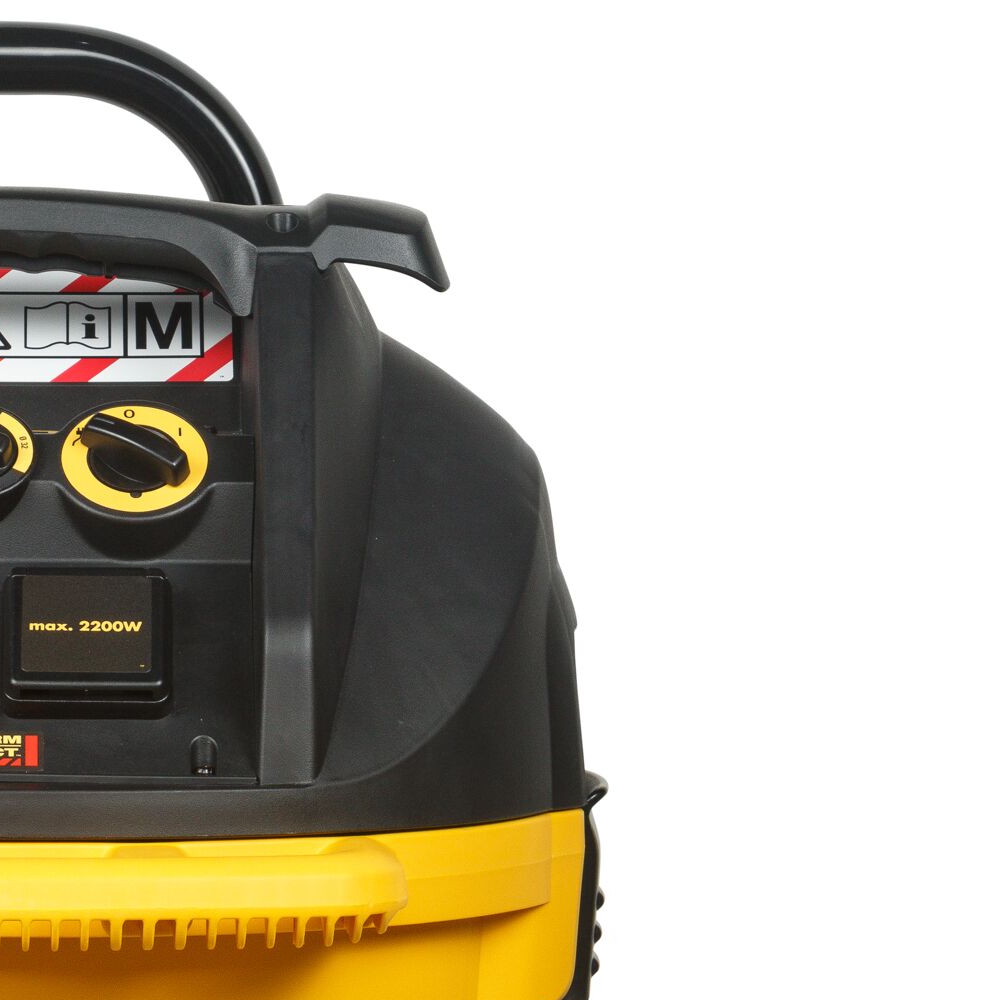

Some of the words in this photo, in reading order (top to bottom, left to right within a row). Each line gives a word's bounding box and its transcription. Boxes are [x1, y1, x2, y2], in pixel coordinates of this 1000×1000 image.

[134, 301, 193, 350] M
[29, 622, 73, 632] max.
[79, 620, 143, 632] 2200W
